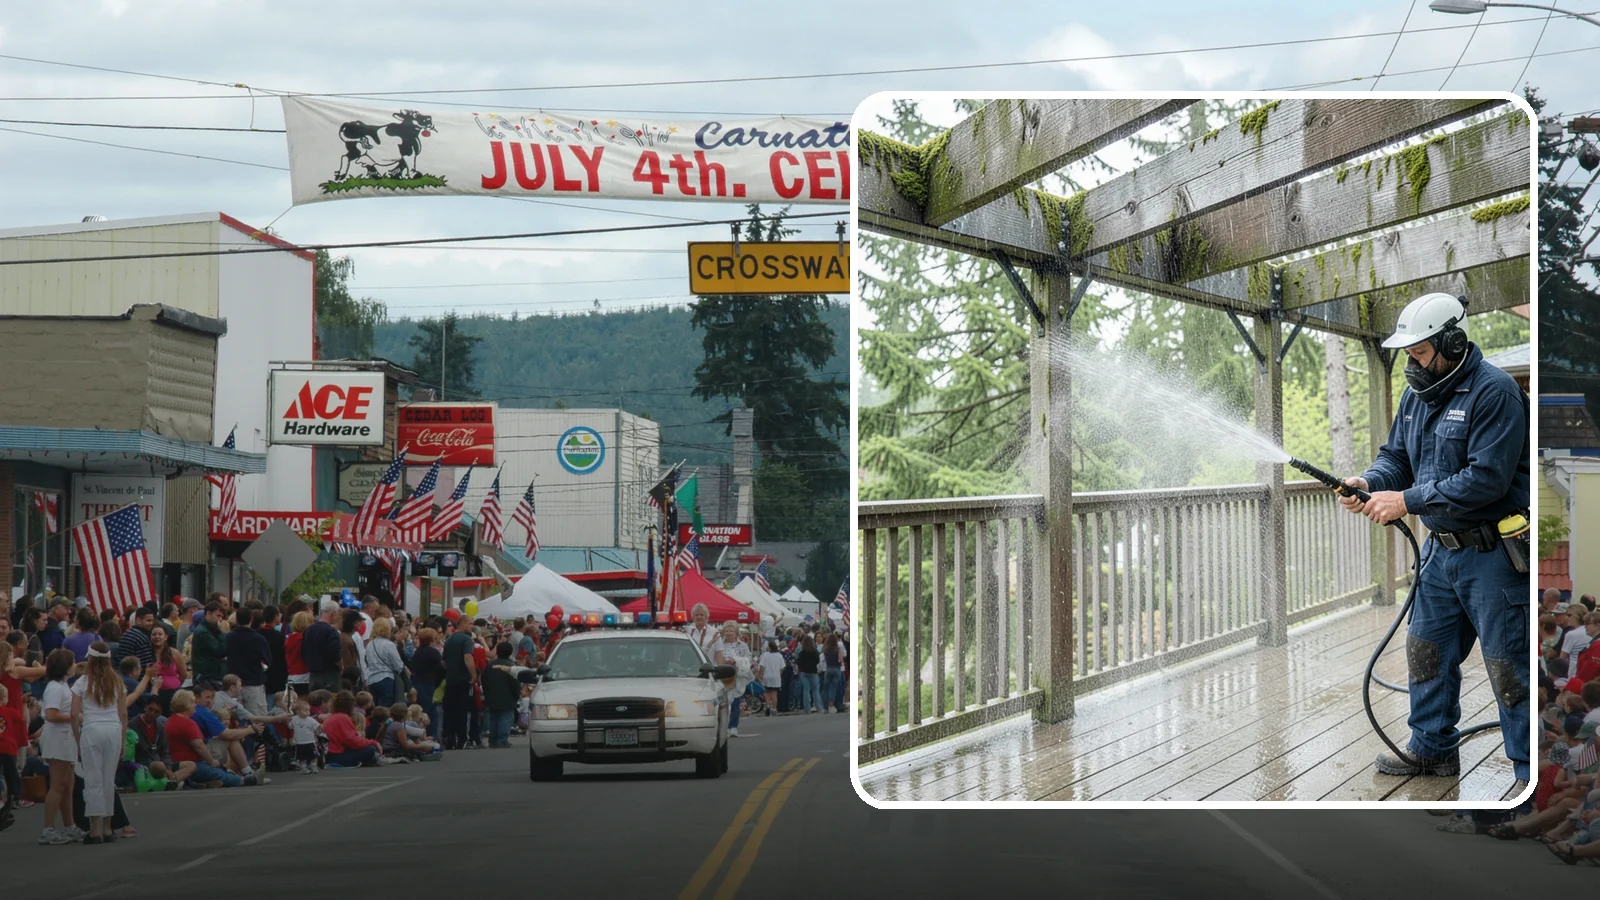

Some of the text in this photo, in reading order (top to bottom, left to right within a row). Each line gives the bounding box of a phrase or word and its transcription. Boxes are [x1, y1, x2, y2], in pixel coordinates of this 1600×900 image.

[481, 141, 605, 193] JULY
[632, 150, 747, 198] 4th.
[696, 254, 851, 281] CROSSWA
[282, 380, 374, 420] ACE
[405, 409, 486, 421] CEDAR LOG
[282, 420, 371, 438] Hardware
[416, 428, 478, 447] Coca-Cola
[353, 467, 385, 480] Simpl
[83, 485, 156, 496] St. Vincent de Paul
[80, 503, 155, 522] THT
[212, 516, 331, 536] HARDARE
[687, 526, 742, 535] CRNATION
[699, 535, 731, 543] GLASS
